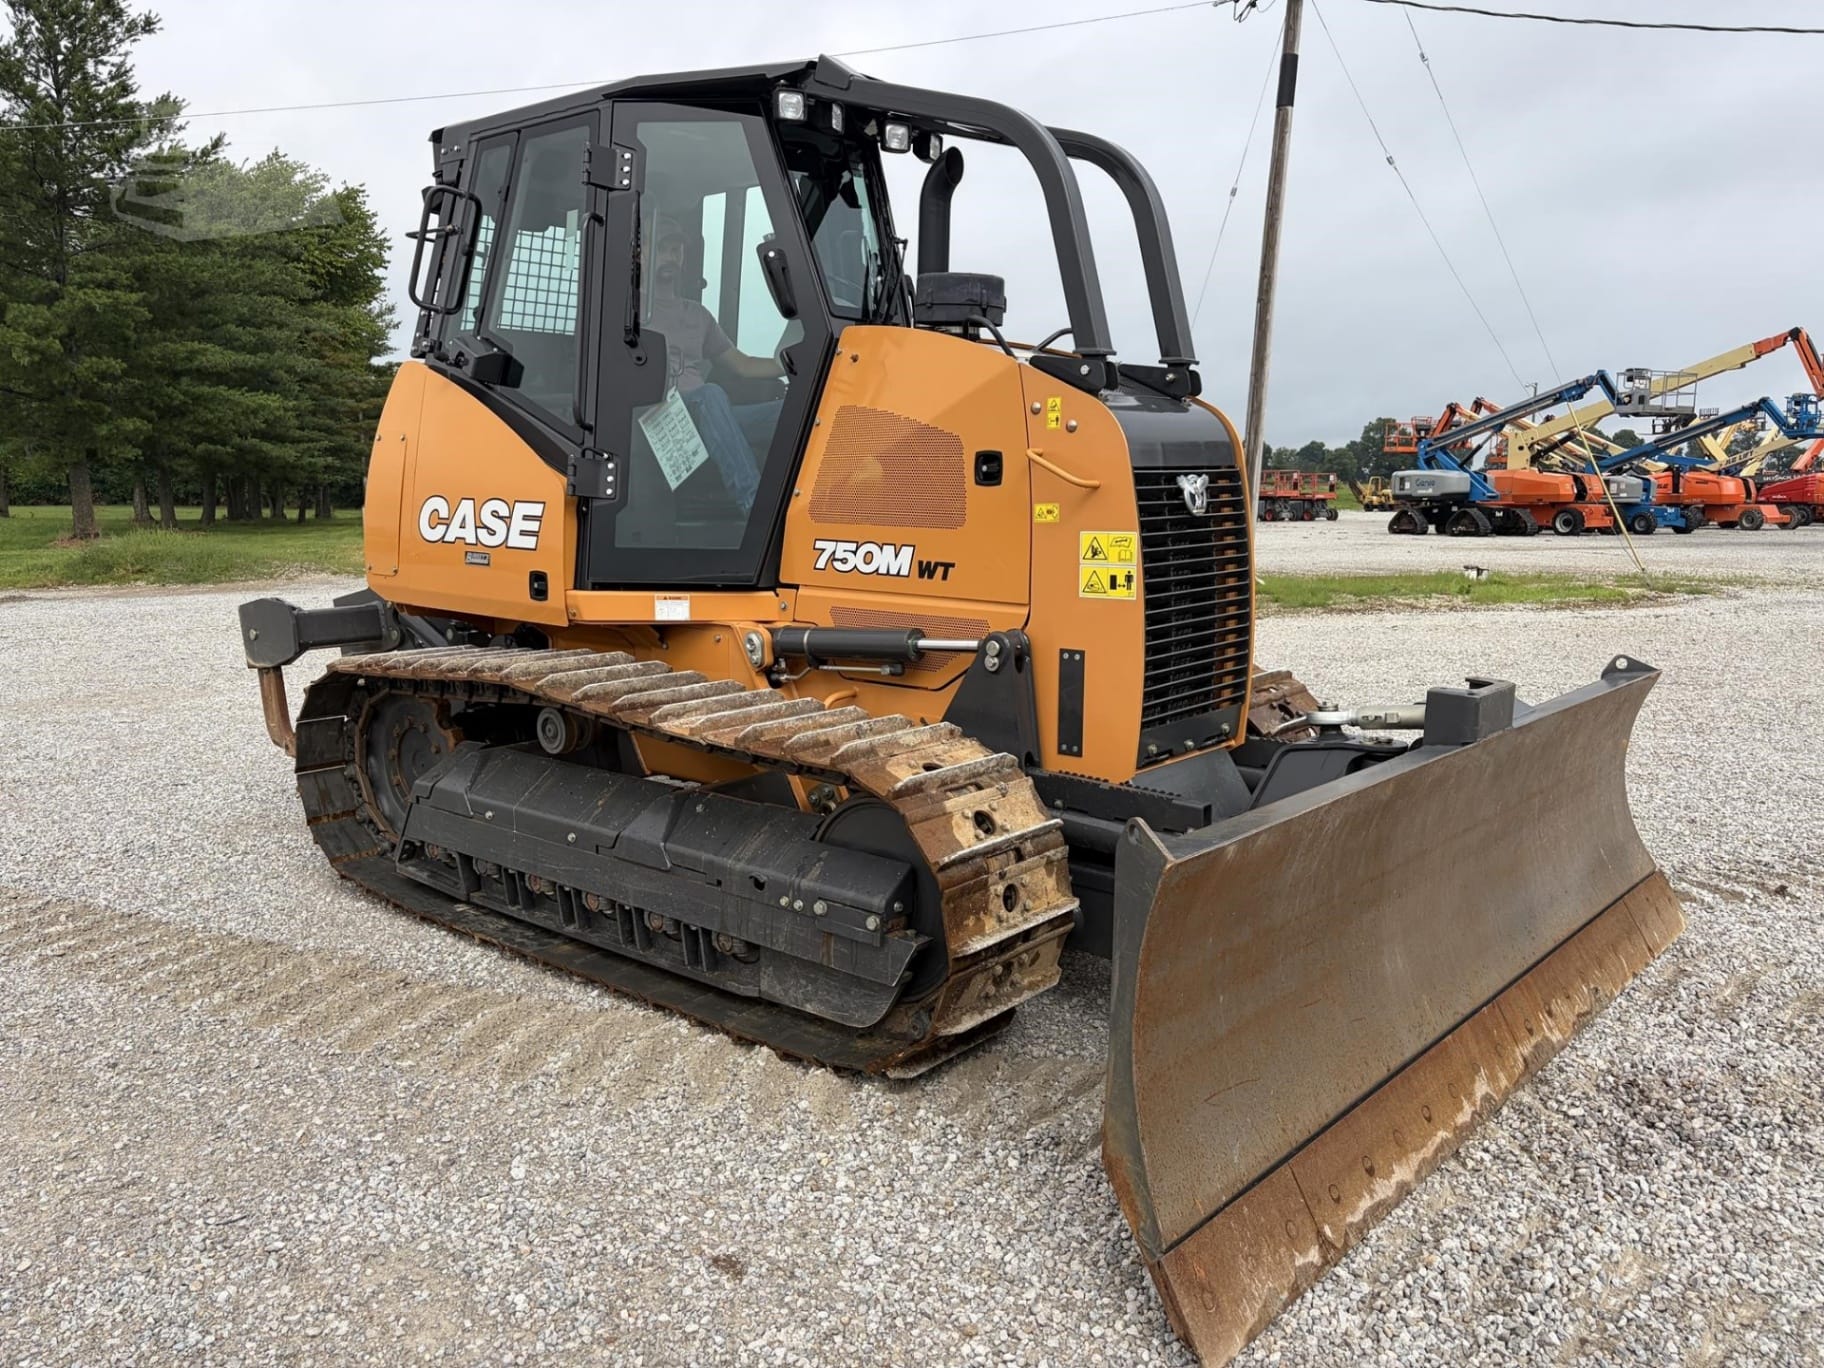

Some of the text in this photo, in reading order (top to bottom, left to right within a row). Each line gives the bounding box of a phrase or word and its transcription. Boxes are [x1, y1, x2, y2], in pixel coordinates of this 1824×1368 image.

[1415, 478, 1436, 487] Genie
[418, 494, 546, 551] CASE
[813, 538, 956, 581] 750M WT
